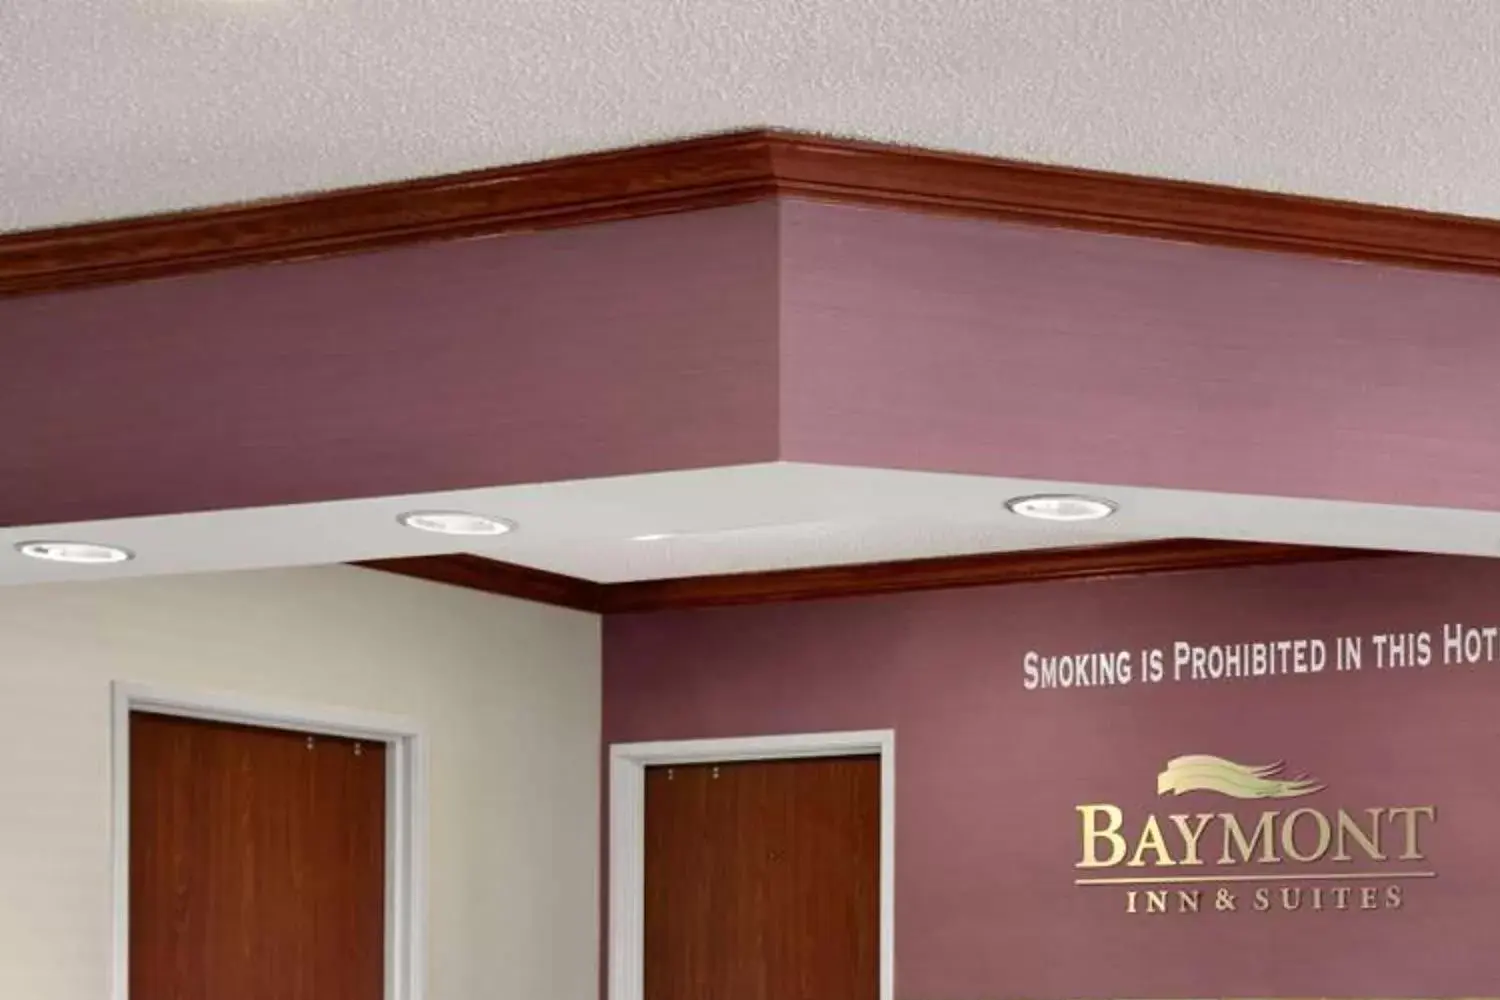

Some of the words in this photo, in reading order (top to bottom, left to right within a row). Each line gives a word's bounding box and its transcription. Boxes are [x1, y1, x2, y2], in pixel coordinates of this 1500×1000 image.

[1023, 651, 1132, 690] SMOKING
[1142, 649, 1164, 683] IS
[1173, 639, 1326, 681] PROHIBITED
[1336, 636, 1361, 671] IN
[1372, 632, 1432, 668] THIS
[1075, 804, 1436, 869] BAYMONT
[1126, 890, 1202, 914] INN
[1215, 888, 1237, 911] &
[1253, 885, 1403, 912] SUITES
